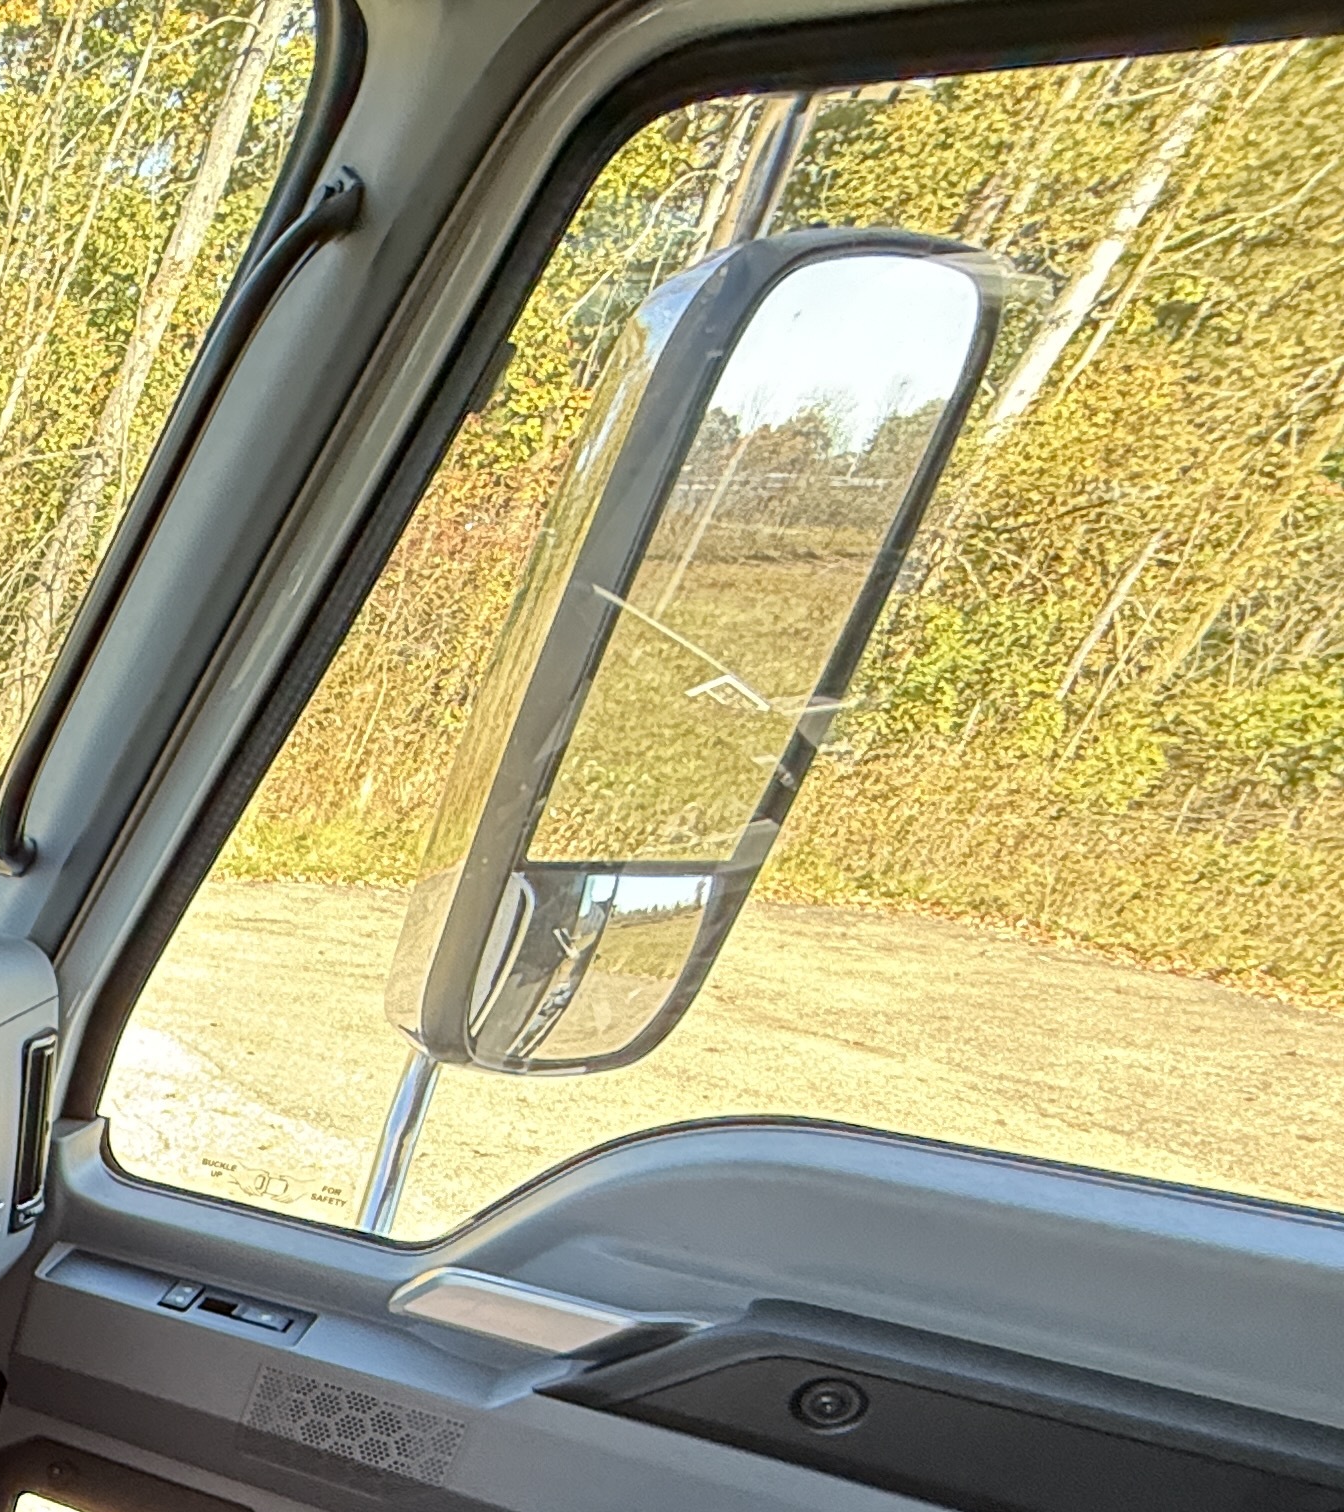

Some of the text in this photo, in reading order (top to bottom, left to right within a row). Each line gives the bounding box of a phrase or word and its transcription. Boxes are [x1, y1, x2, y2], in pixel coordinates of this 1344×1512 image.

[201, 1157, 238, 1172] BUCKLE
[210, 1170, 223, 1178] UP
[321, 1185, 343, 1197] FOR
[310, 1192, 348, 1208] SAFETY
